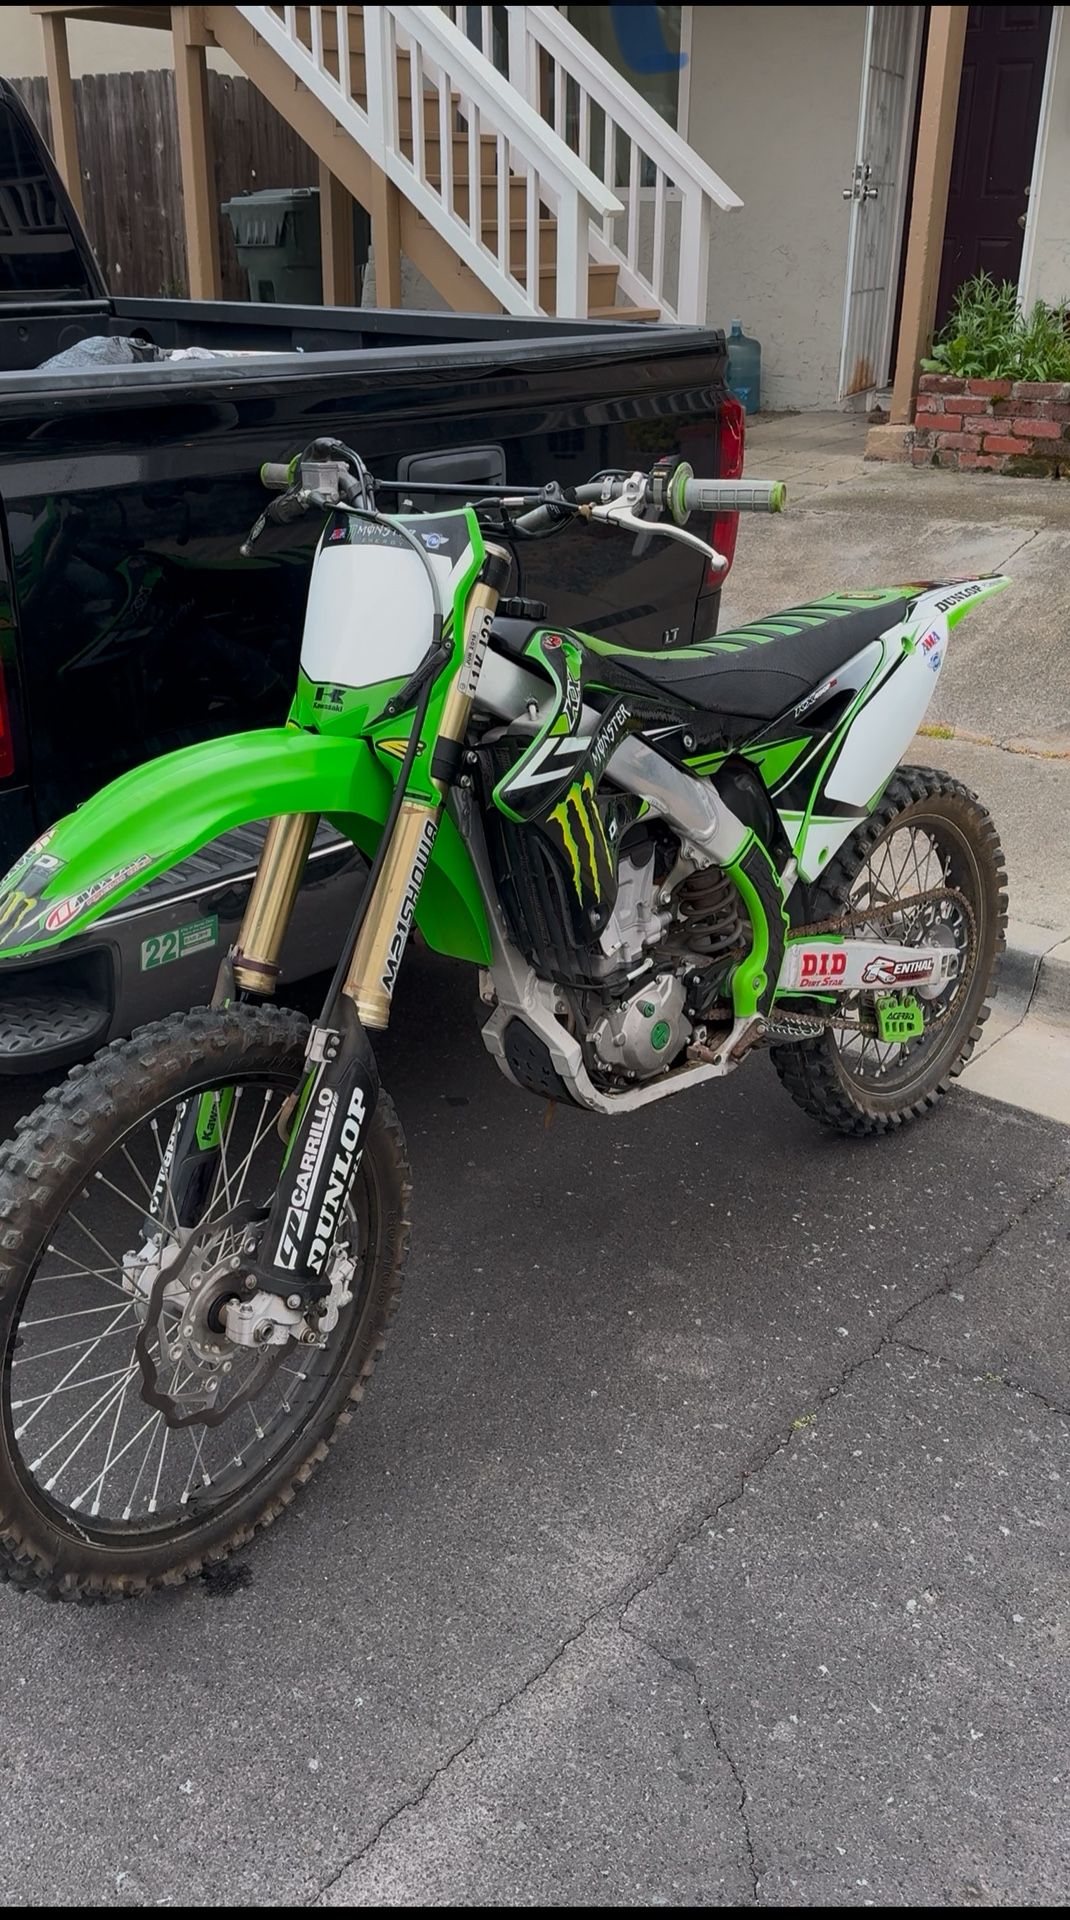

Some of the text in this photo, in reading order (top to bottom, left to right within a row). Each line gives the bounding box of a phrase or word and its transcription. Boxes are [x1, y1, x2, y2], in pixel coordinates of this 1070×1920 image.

[357, 523, 416, 537] MONSTR
[934, 584, 982, 613] DUNLOP
[664, 627, 679, 644] LT
[592, 703, 632, 767] MONSTER
[145, 933, 178, 969] 22
[291, 1088, 334, 1207] CARRILLO
[306, 1087, 365, 1275] DUNLOP
